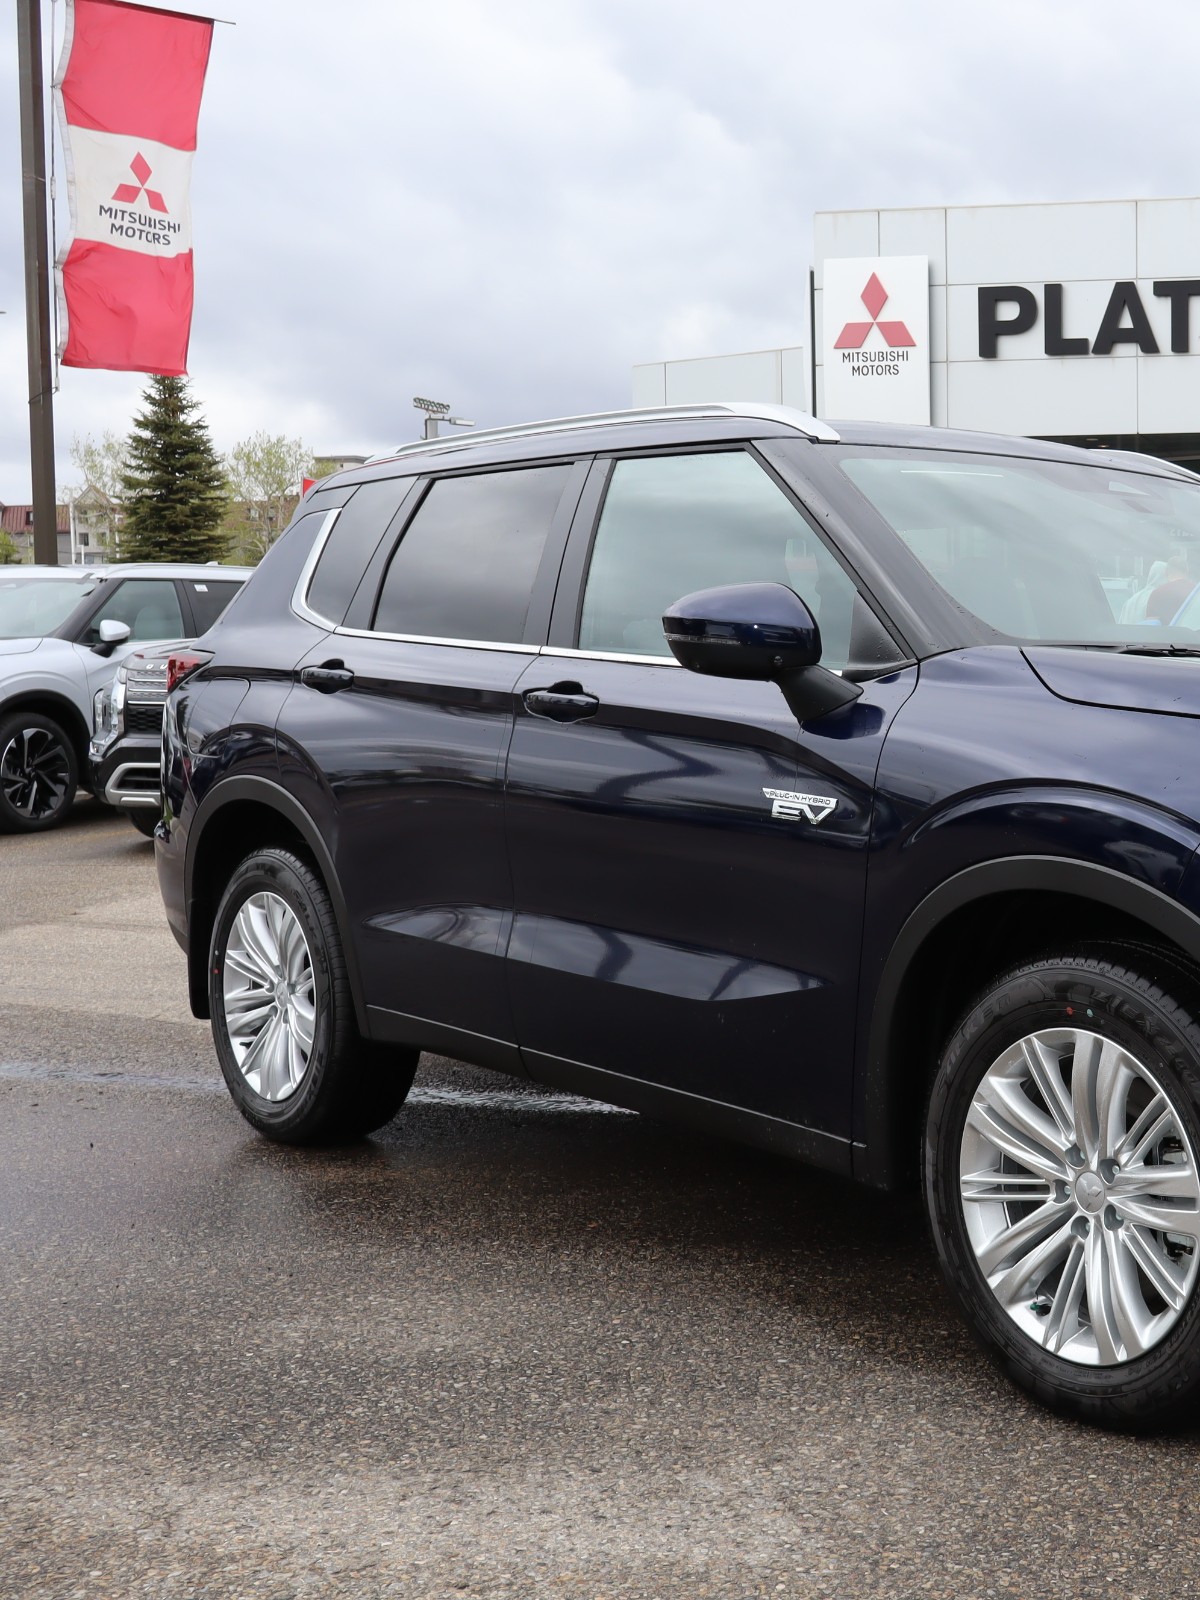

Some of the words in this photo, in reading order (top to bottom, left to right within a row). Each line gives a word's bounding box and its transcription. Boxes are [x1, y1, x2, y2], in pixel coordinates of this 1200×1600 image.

[110, 222, 171, 246] MOTORS
[842, 350, 909, 363] MITSUBISHI
[852, 364, 900, 376] MOTORS
[769, 791, 800, 801] PLUG-IN
[800, 796, 831, 806] HYBRID
